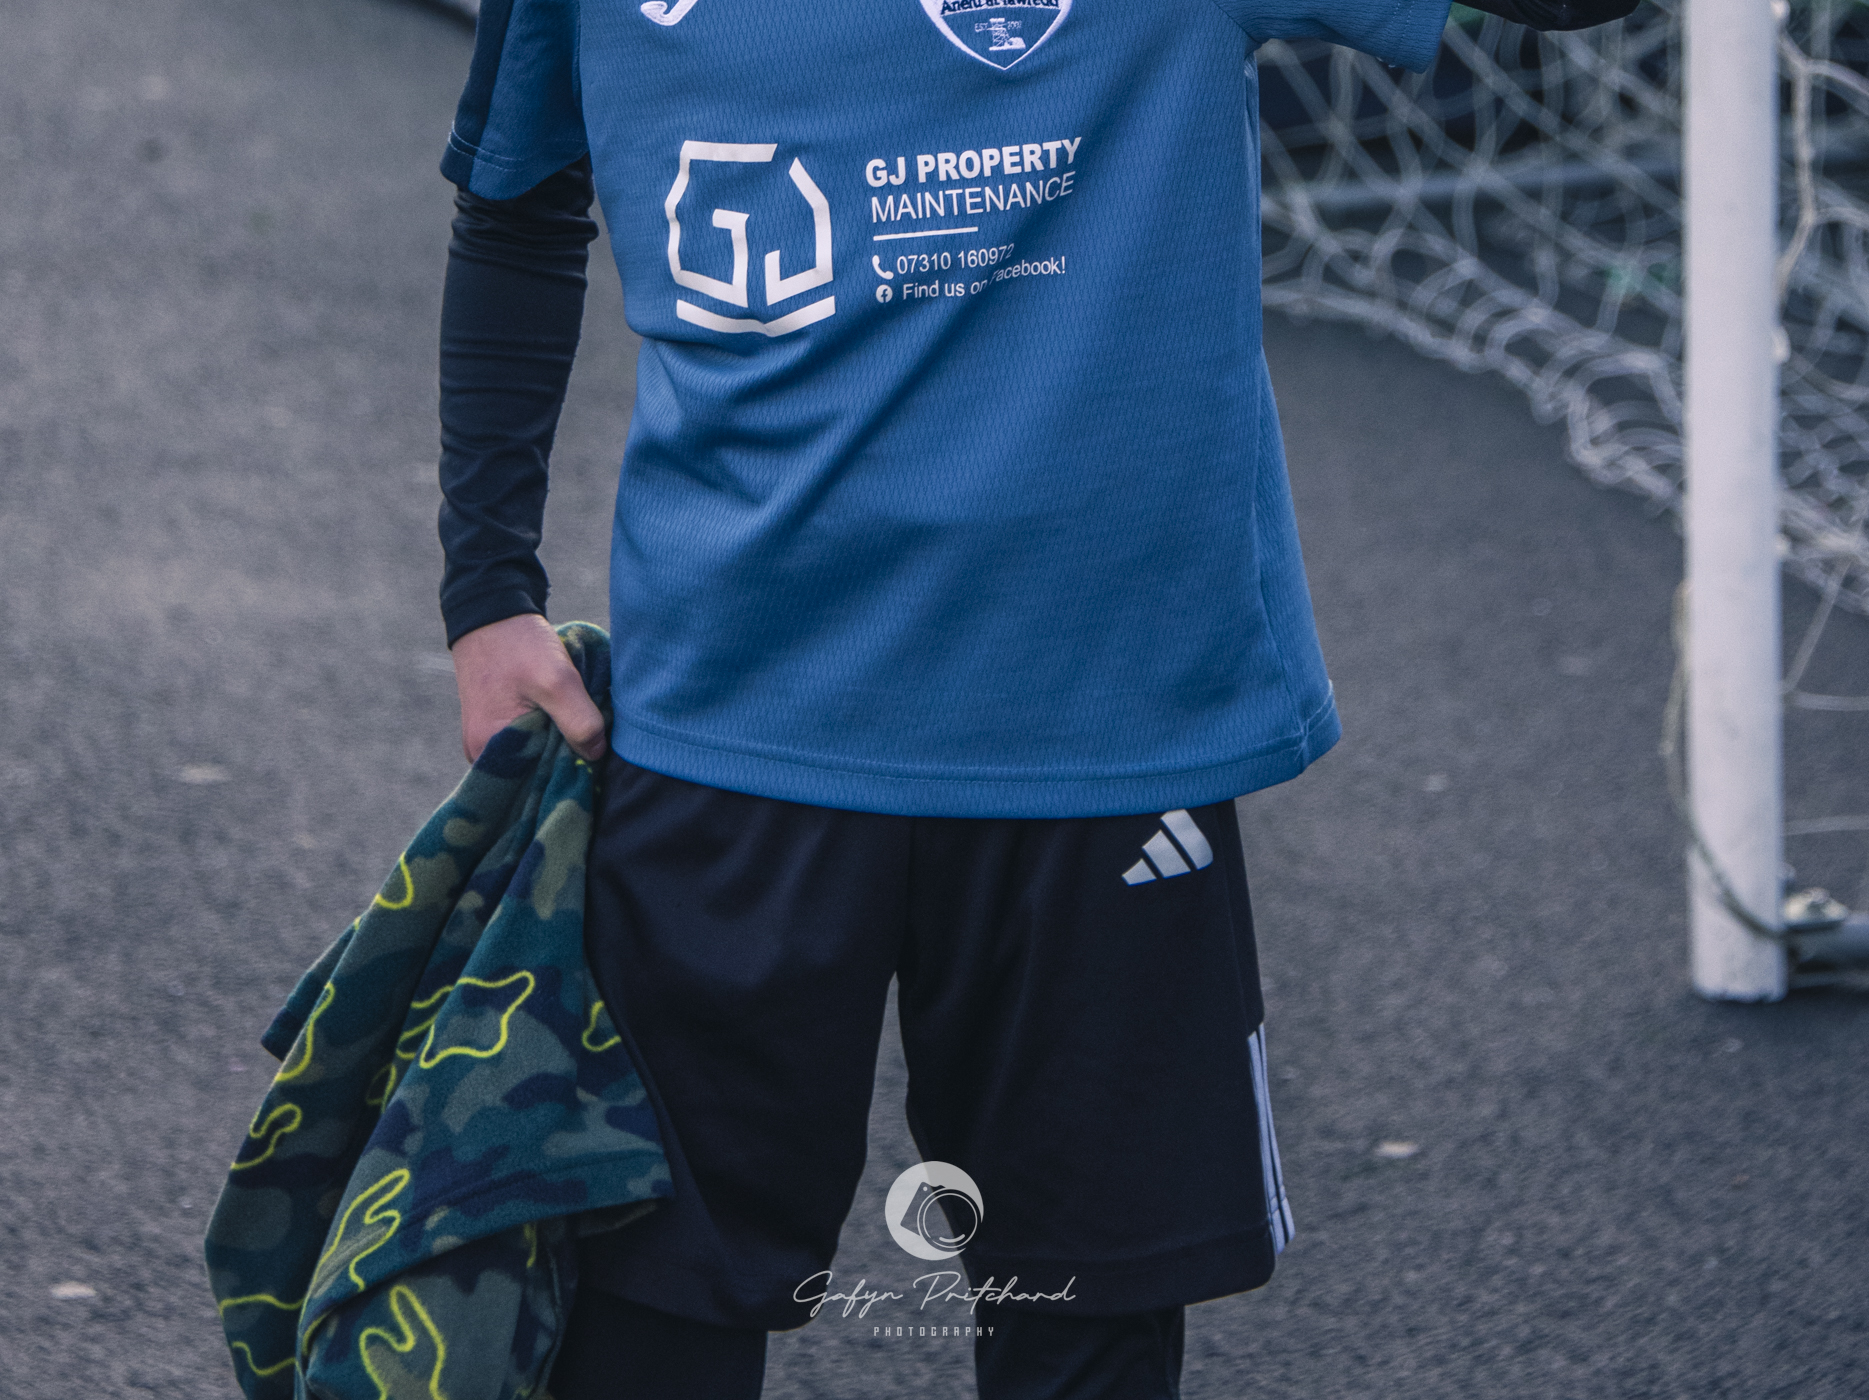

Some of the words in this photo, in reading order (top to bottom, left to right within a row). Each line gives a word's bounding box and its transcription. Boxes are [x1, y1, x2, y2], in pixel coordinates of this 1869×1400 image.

[865, 156, 907, 188] GJ
[916, 136, 1082, 184] PROPERTY
[871, 171, 1076, 223] MAINTENANCE
[896, 252, 951, 275] 07310
[957, 243, 1015, 269] 160972
[903, 280, 939, 300] Find
[944, 283, 965, 297] us
[970, 280, 988, 295] on
